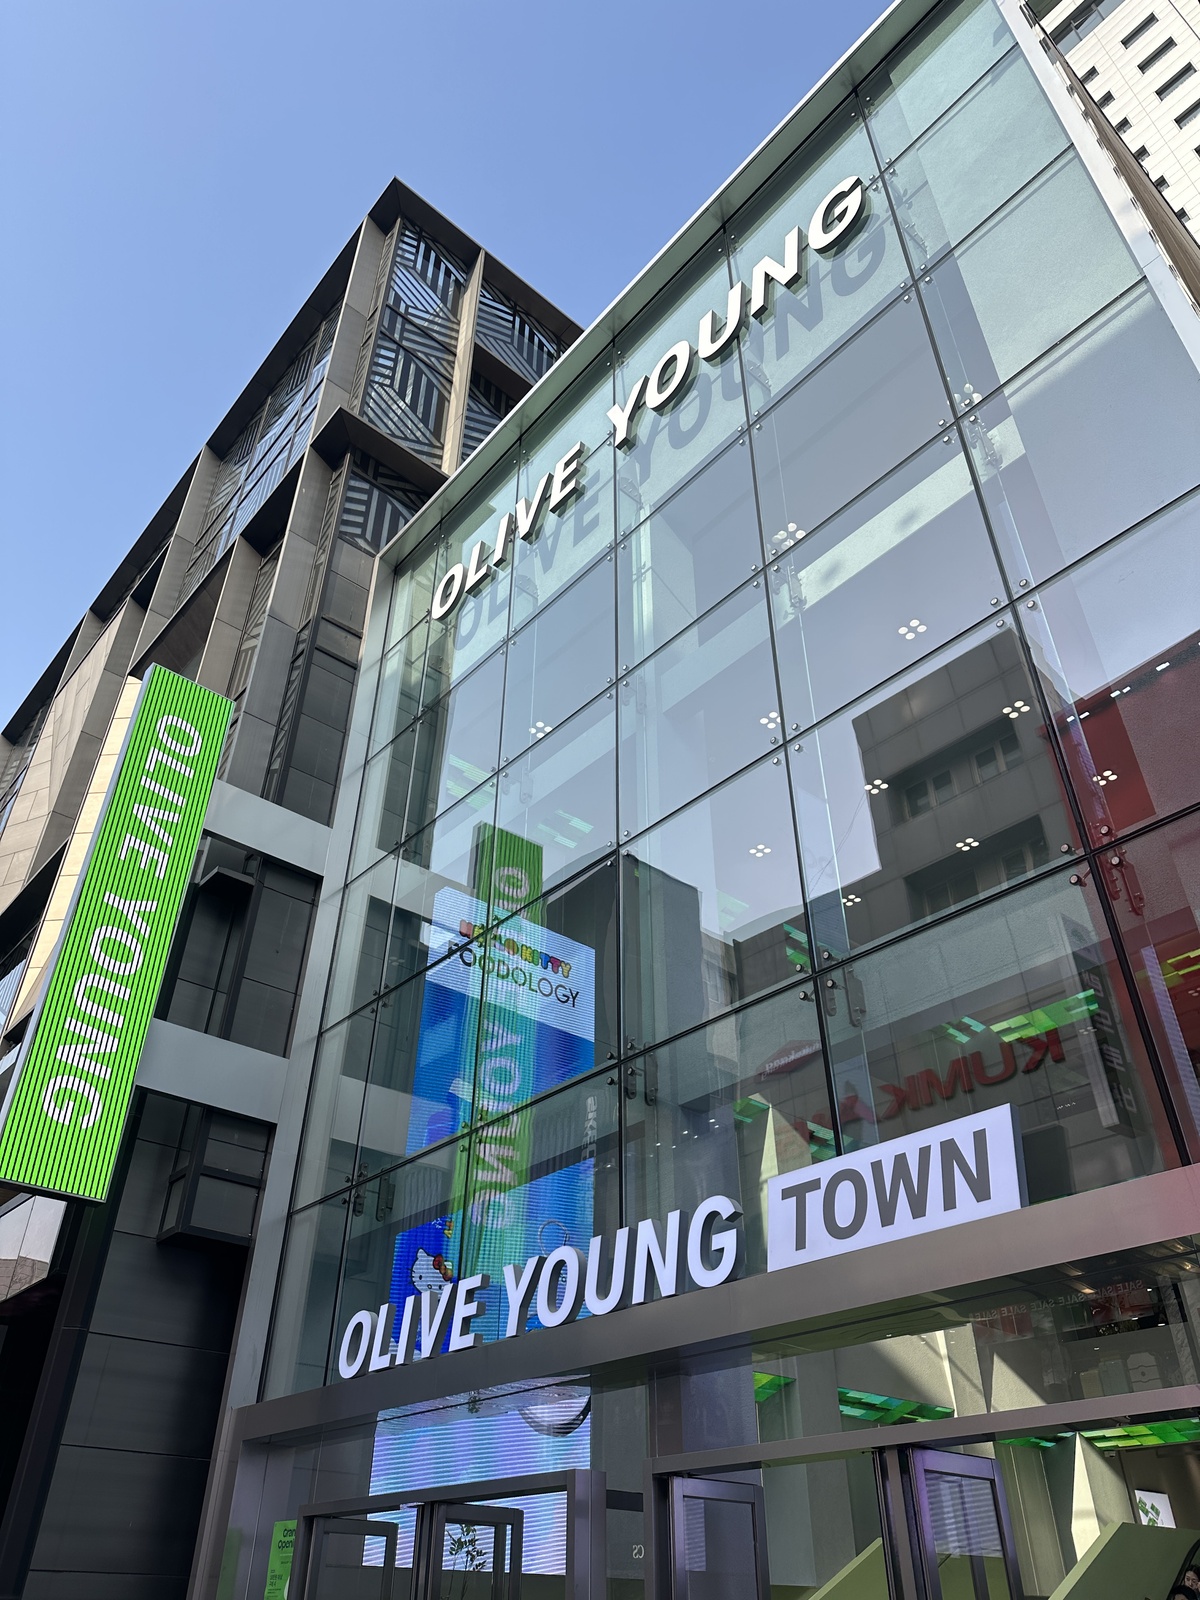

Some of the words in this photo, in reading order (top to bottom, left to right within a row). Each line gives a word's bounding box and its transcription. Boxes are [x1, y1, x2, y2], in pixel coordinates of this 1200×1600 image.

[431, 442, 586, 620] OLIVE
[606, 175, 866, 450] YOUNG
[123, 714, 203, 881] OLIVE
[448, 940, 579, 1007] FOODOLOGY
[459, 917, 519, 956] HELO
[521, 943, 571, 978] KITTY
[42, 891, 158, 1131] YOUNG
[338, 1273, 489, 1380] OLIVE
[504, 1195, 743, 1338] YOUNG
[781, 1128, 992, 1252] TOWN
[277, 1538, 295, 1551] Openi
[282, 1528, 297, 1538] Gran
